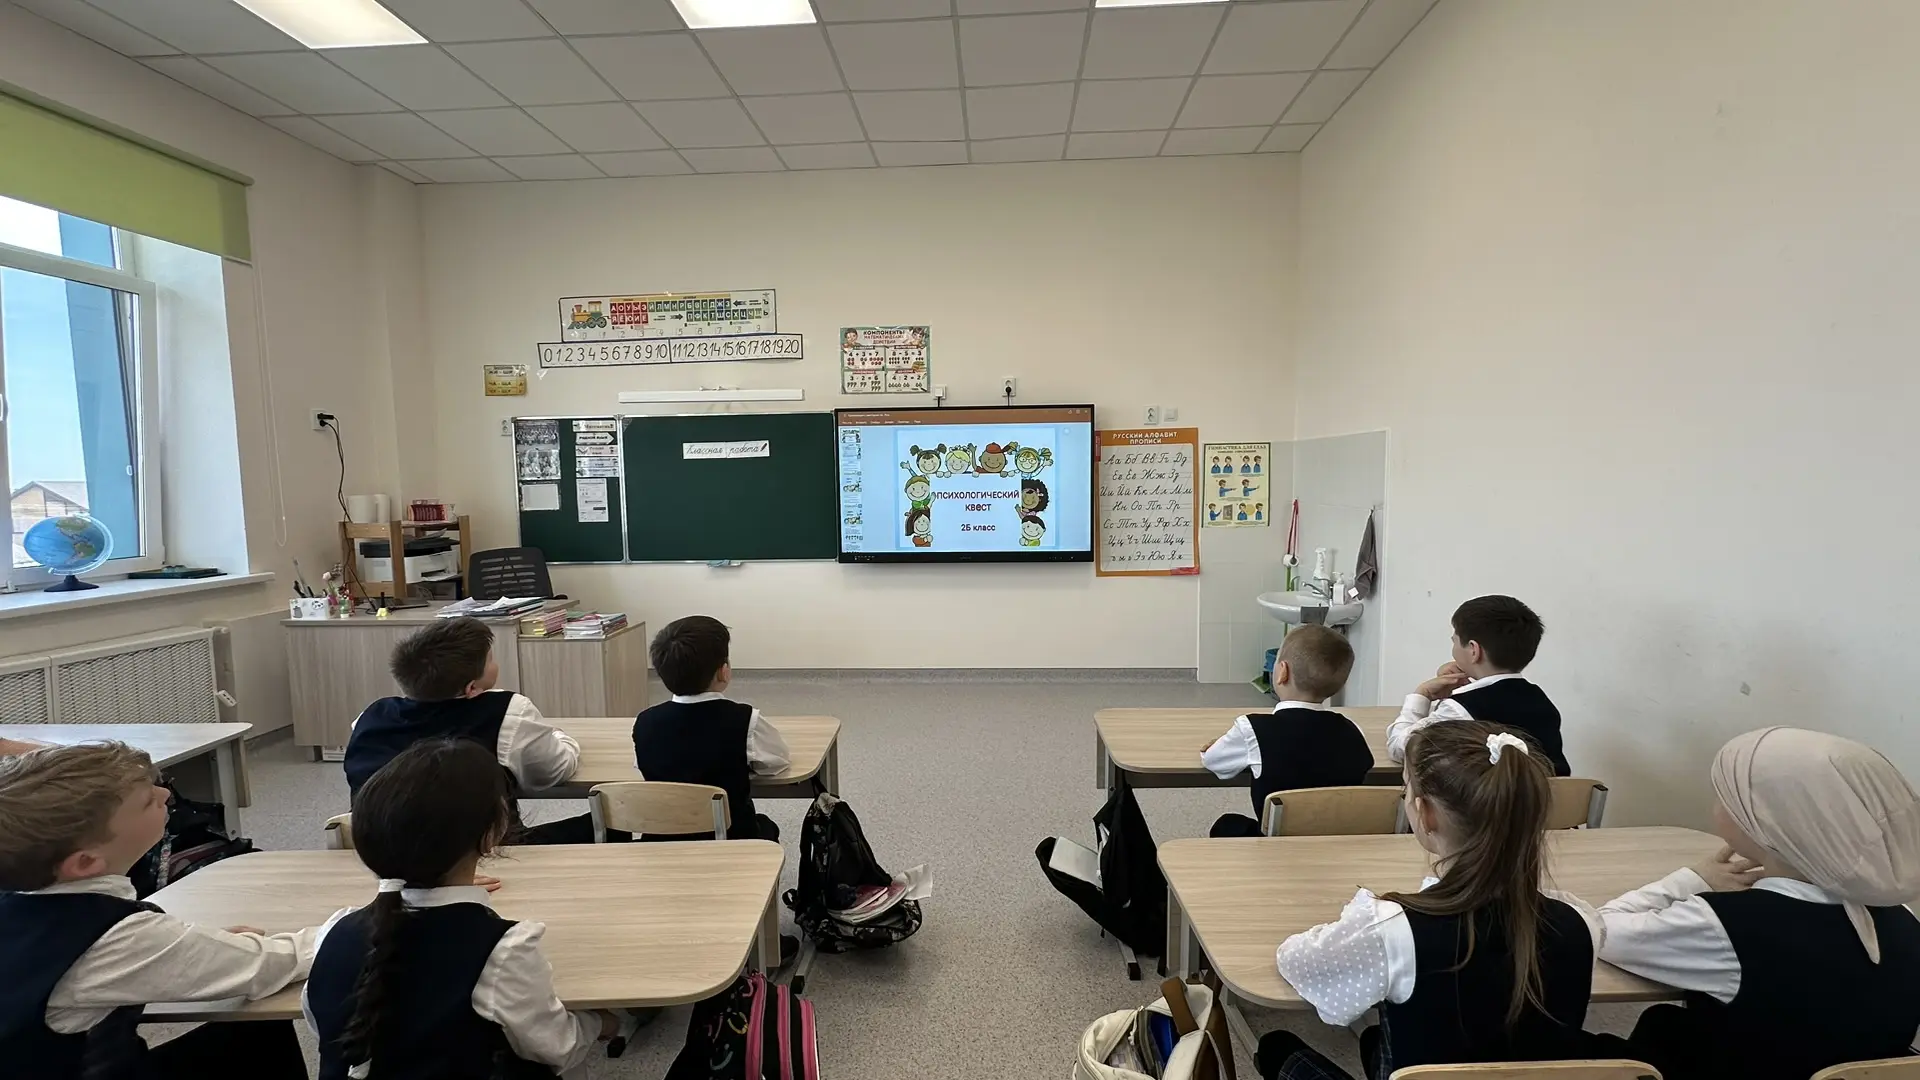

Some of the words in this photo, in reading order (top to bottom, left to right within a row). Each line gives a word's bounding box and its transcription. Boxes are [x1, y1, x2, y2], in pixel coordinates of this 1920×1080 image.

[544, 348, 553, 362] 0
[556, 348, 561, 361] 1
[565, 347, 573, 361] 2
[577, 347, 585, 361] 3
[588, 347, 596, 361] 4
[600, 346, 609, 361] 5
[612, 346, 620, 360] 6
[623, 346, 631, 360] 7
[633, 344, 641, 359] 8
[645, 344, 653, 359] 9
[655, 343, 668, 359] 10
[672, 342, 681, 357] 11
[683, 342, 695, 357] 12
[697, 342, 708, 357] 13
[709, 342, 720, 357] 14
[722, 341, 734, 356] 15
[735, 341, 746, 355] 16
[747, 340, 759, 355] 17
[760, 339, 771, 354] 18
[772, 339, 784, 354] 19
[784, 339, 800, 354] 20
[1144, 431, 1178, 439] АЛФАВИТ
[937, 490, 1020, 500] ПСИХОЛОГИЧЕСКИЙ
[961, 523, 971, 532] 2Б
[973, 524, 996, 532] класс
